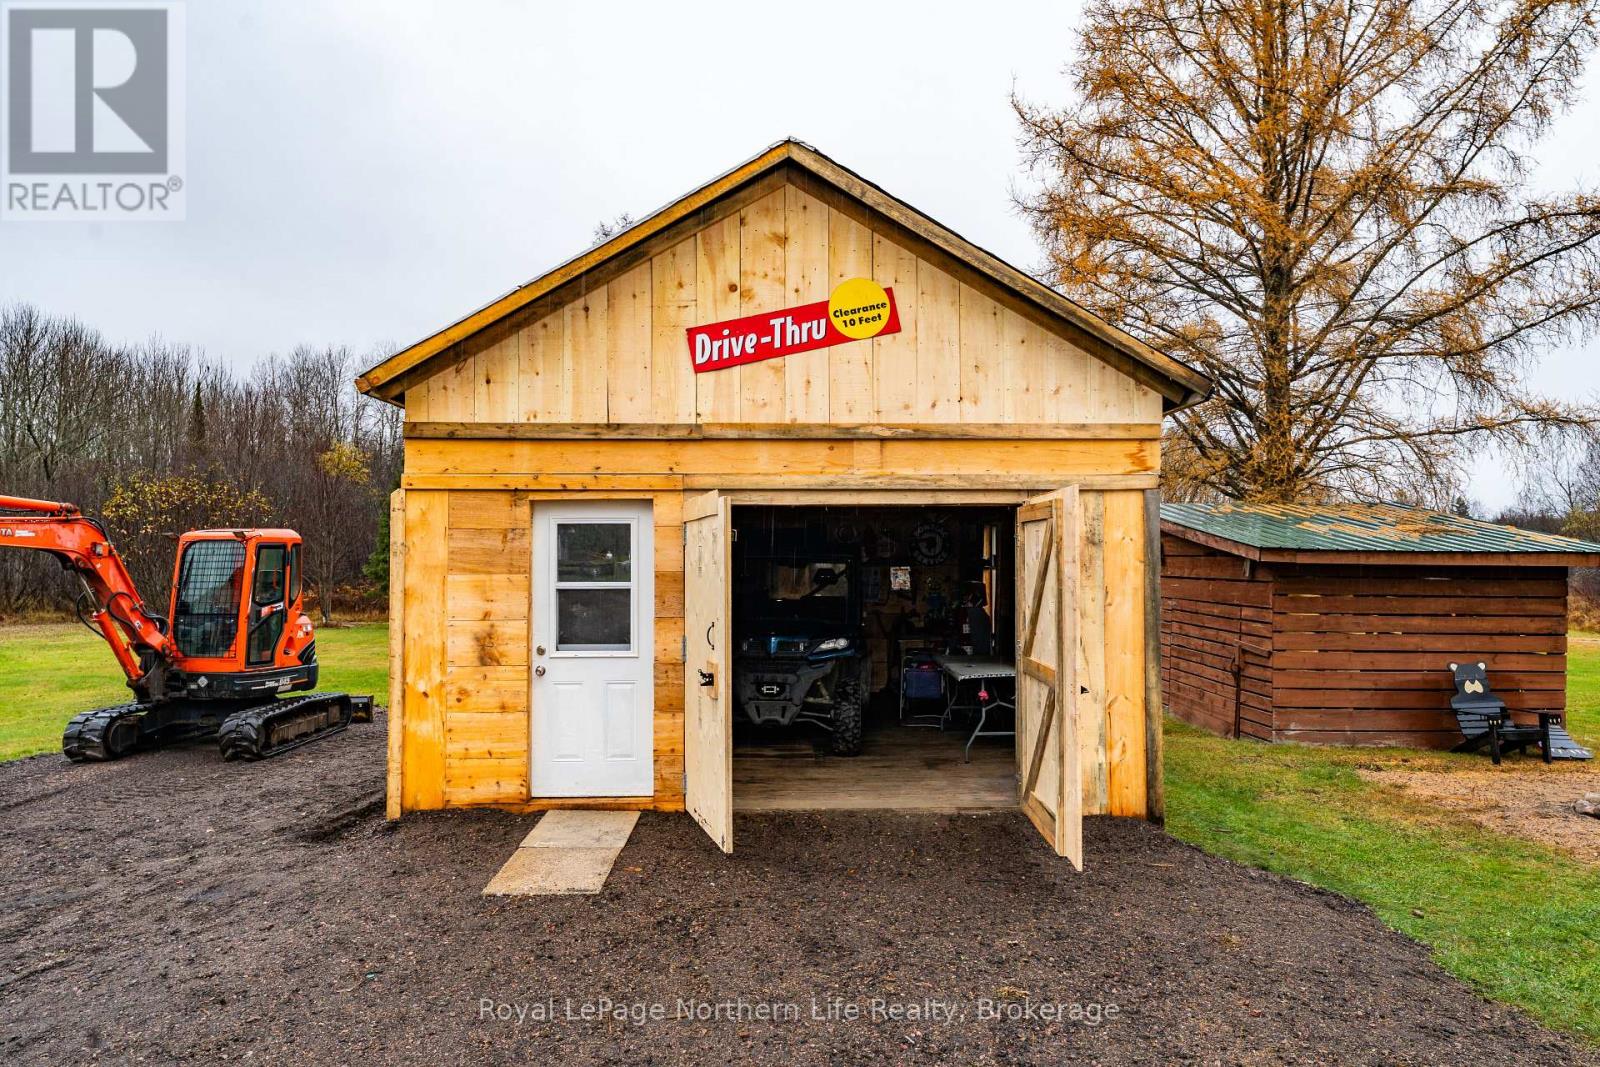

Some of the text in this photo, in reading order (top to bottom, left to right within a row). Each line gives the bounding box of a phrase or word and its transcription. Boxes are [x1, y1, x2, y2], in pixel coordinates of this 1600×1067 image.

[833, 302, 887, 318] Clearance
[842, 313, 882, 328] 10 Feet
[695, 316, 827, 365] Drive-Thru
